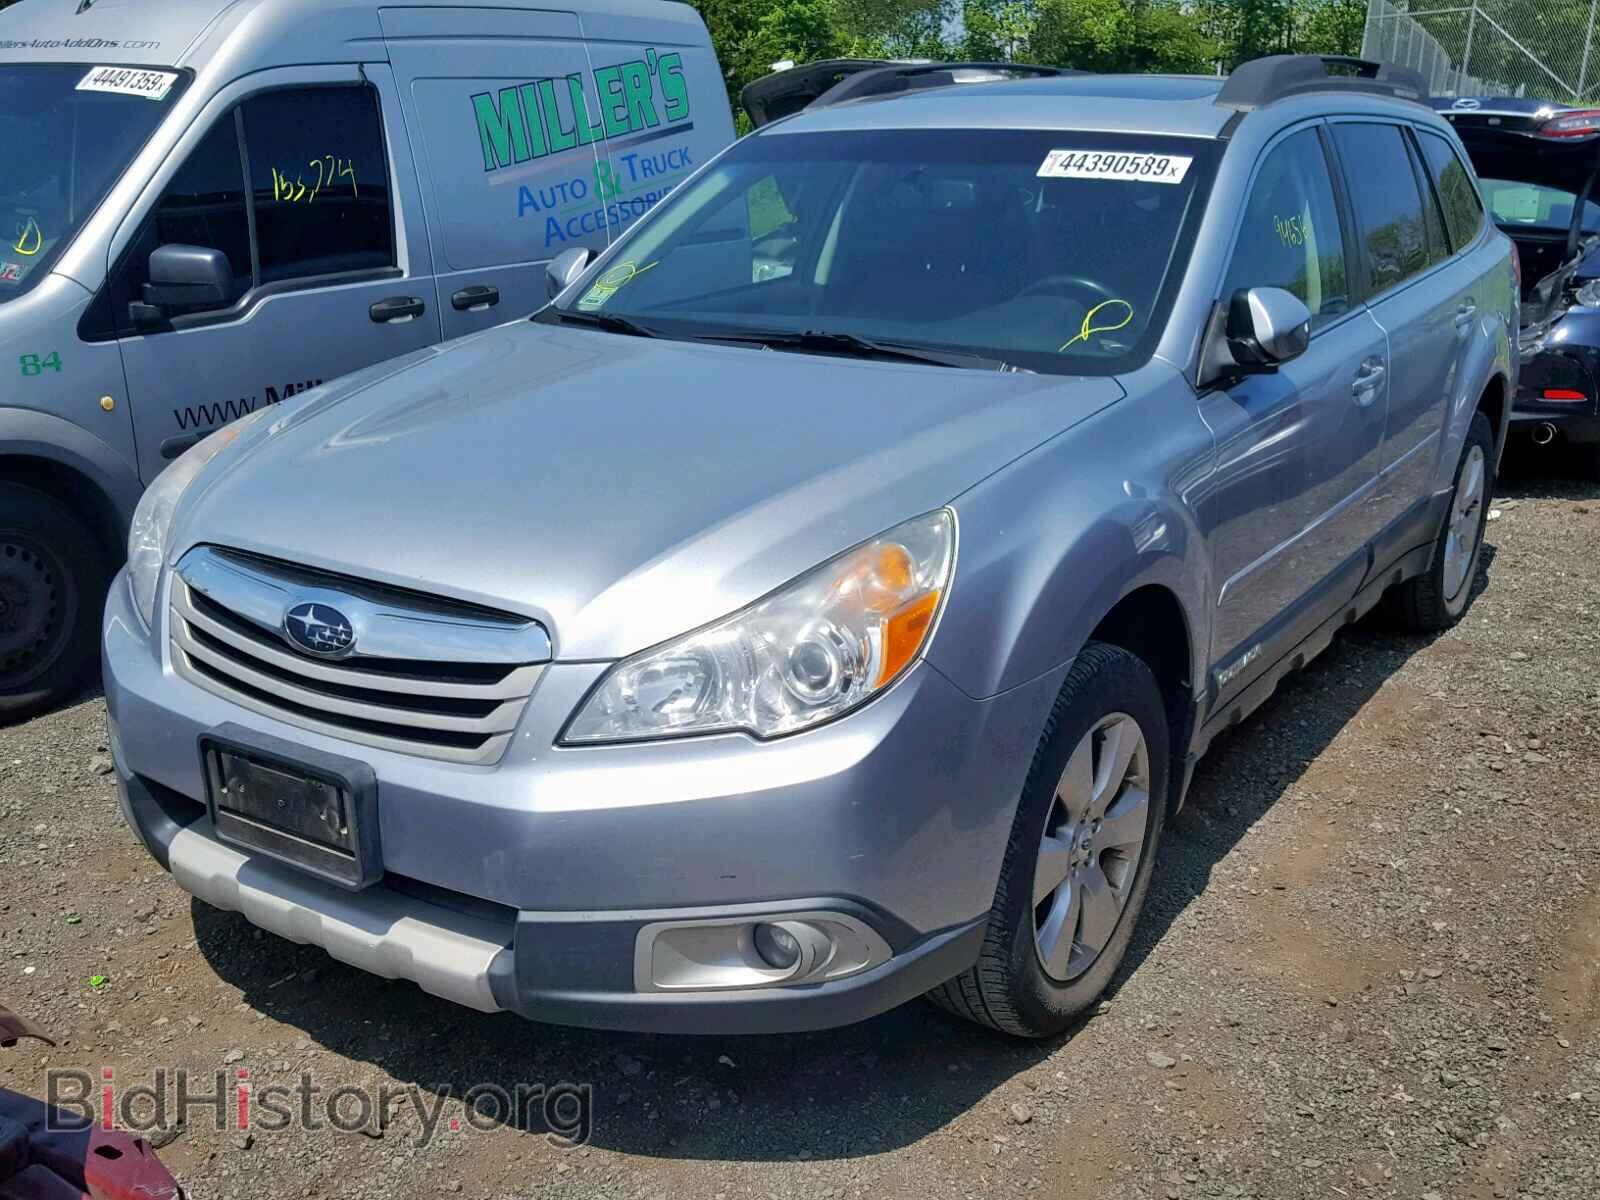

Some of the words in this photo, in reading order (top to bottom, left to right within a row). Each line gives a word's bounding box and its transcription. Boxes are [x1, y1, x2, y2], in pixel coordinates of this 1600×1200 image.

[470, 48, 690, 172] MILLER'S
[516, 178, 587, 218] AUTO
[592, 159, 623, 200] &
[620, 146, 692, 183] TRUCK
[19, 351, 63, 376] 84
